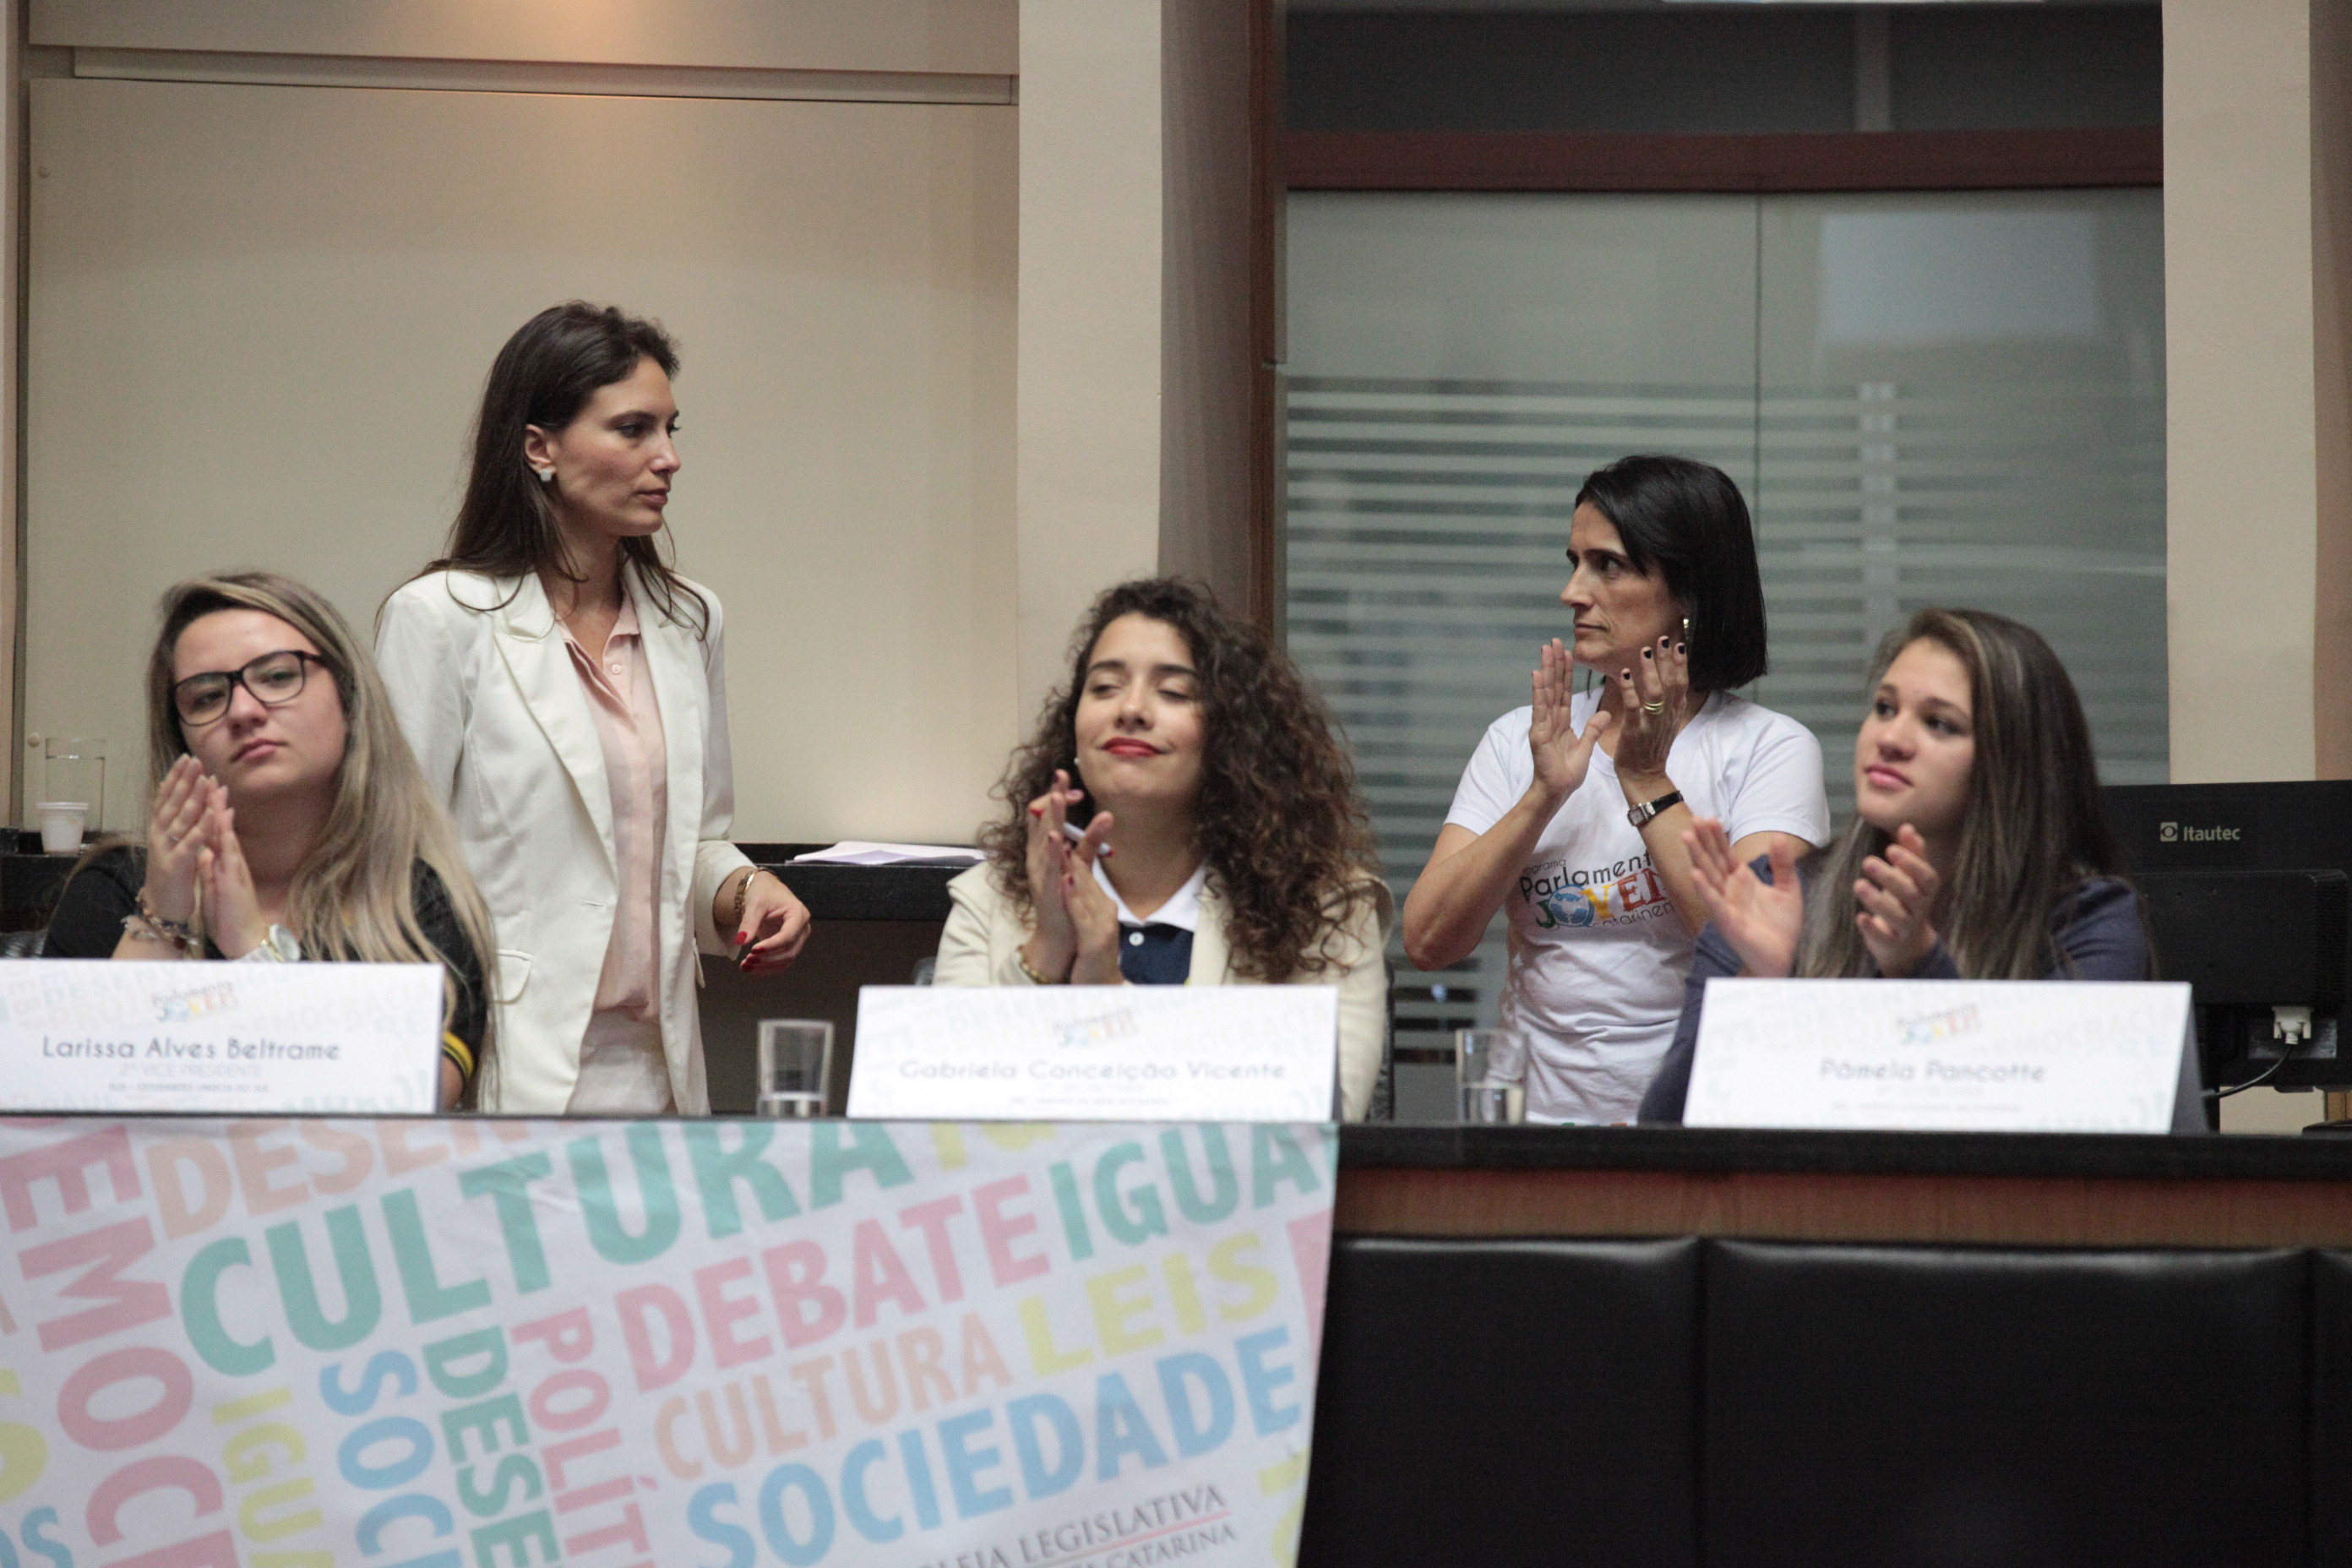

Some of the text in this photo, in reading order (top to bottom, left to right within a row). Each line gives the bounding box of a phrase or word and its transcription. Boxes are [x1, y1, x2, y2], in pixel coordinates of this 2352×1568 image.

[1520, 849, 1652, 903] Parlament
[2182, 825, 2240, 841] Itautec
[42, 1036, 342, 1061] Larissa Alves Beltrame
[141, 1064, 176, 1078] VICE
[180, 1064, 263, 1079] PRESIDENTE
[898, 1058, 1287, 1084] Gabriela Conceição Vicente
[1925, 1059, 2046, 1084] Pancotte
[1048, 1122, 1339, 1261] IGUA
[180, 1120, 915, 1377] CULTURA
[614, 1174, 1052, 1393] DEBATE
[0, 1118, 242, 1568] EMOC
[1018, 1232, 1279, 1379] LEIS
[510, 1307, 659, 1568] POLÍT
[654, 1310, 1013, 1482] CULTURA
[686, 1325, 1303, 1568] SOCIEDADE
[1018, 1484, 1226, 1564] LEGISLATIVA
[1104, 1522, 1239, 1568] CATARINA
